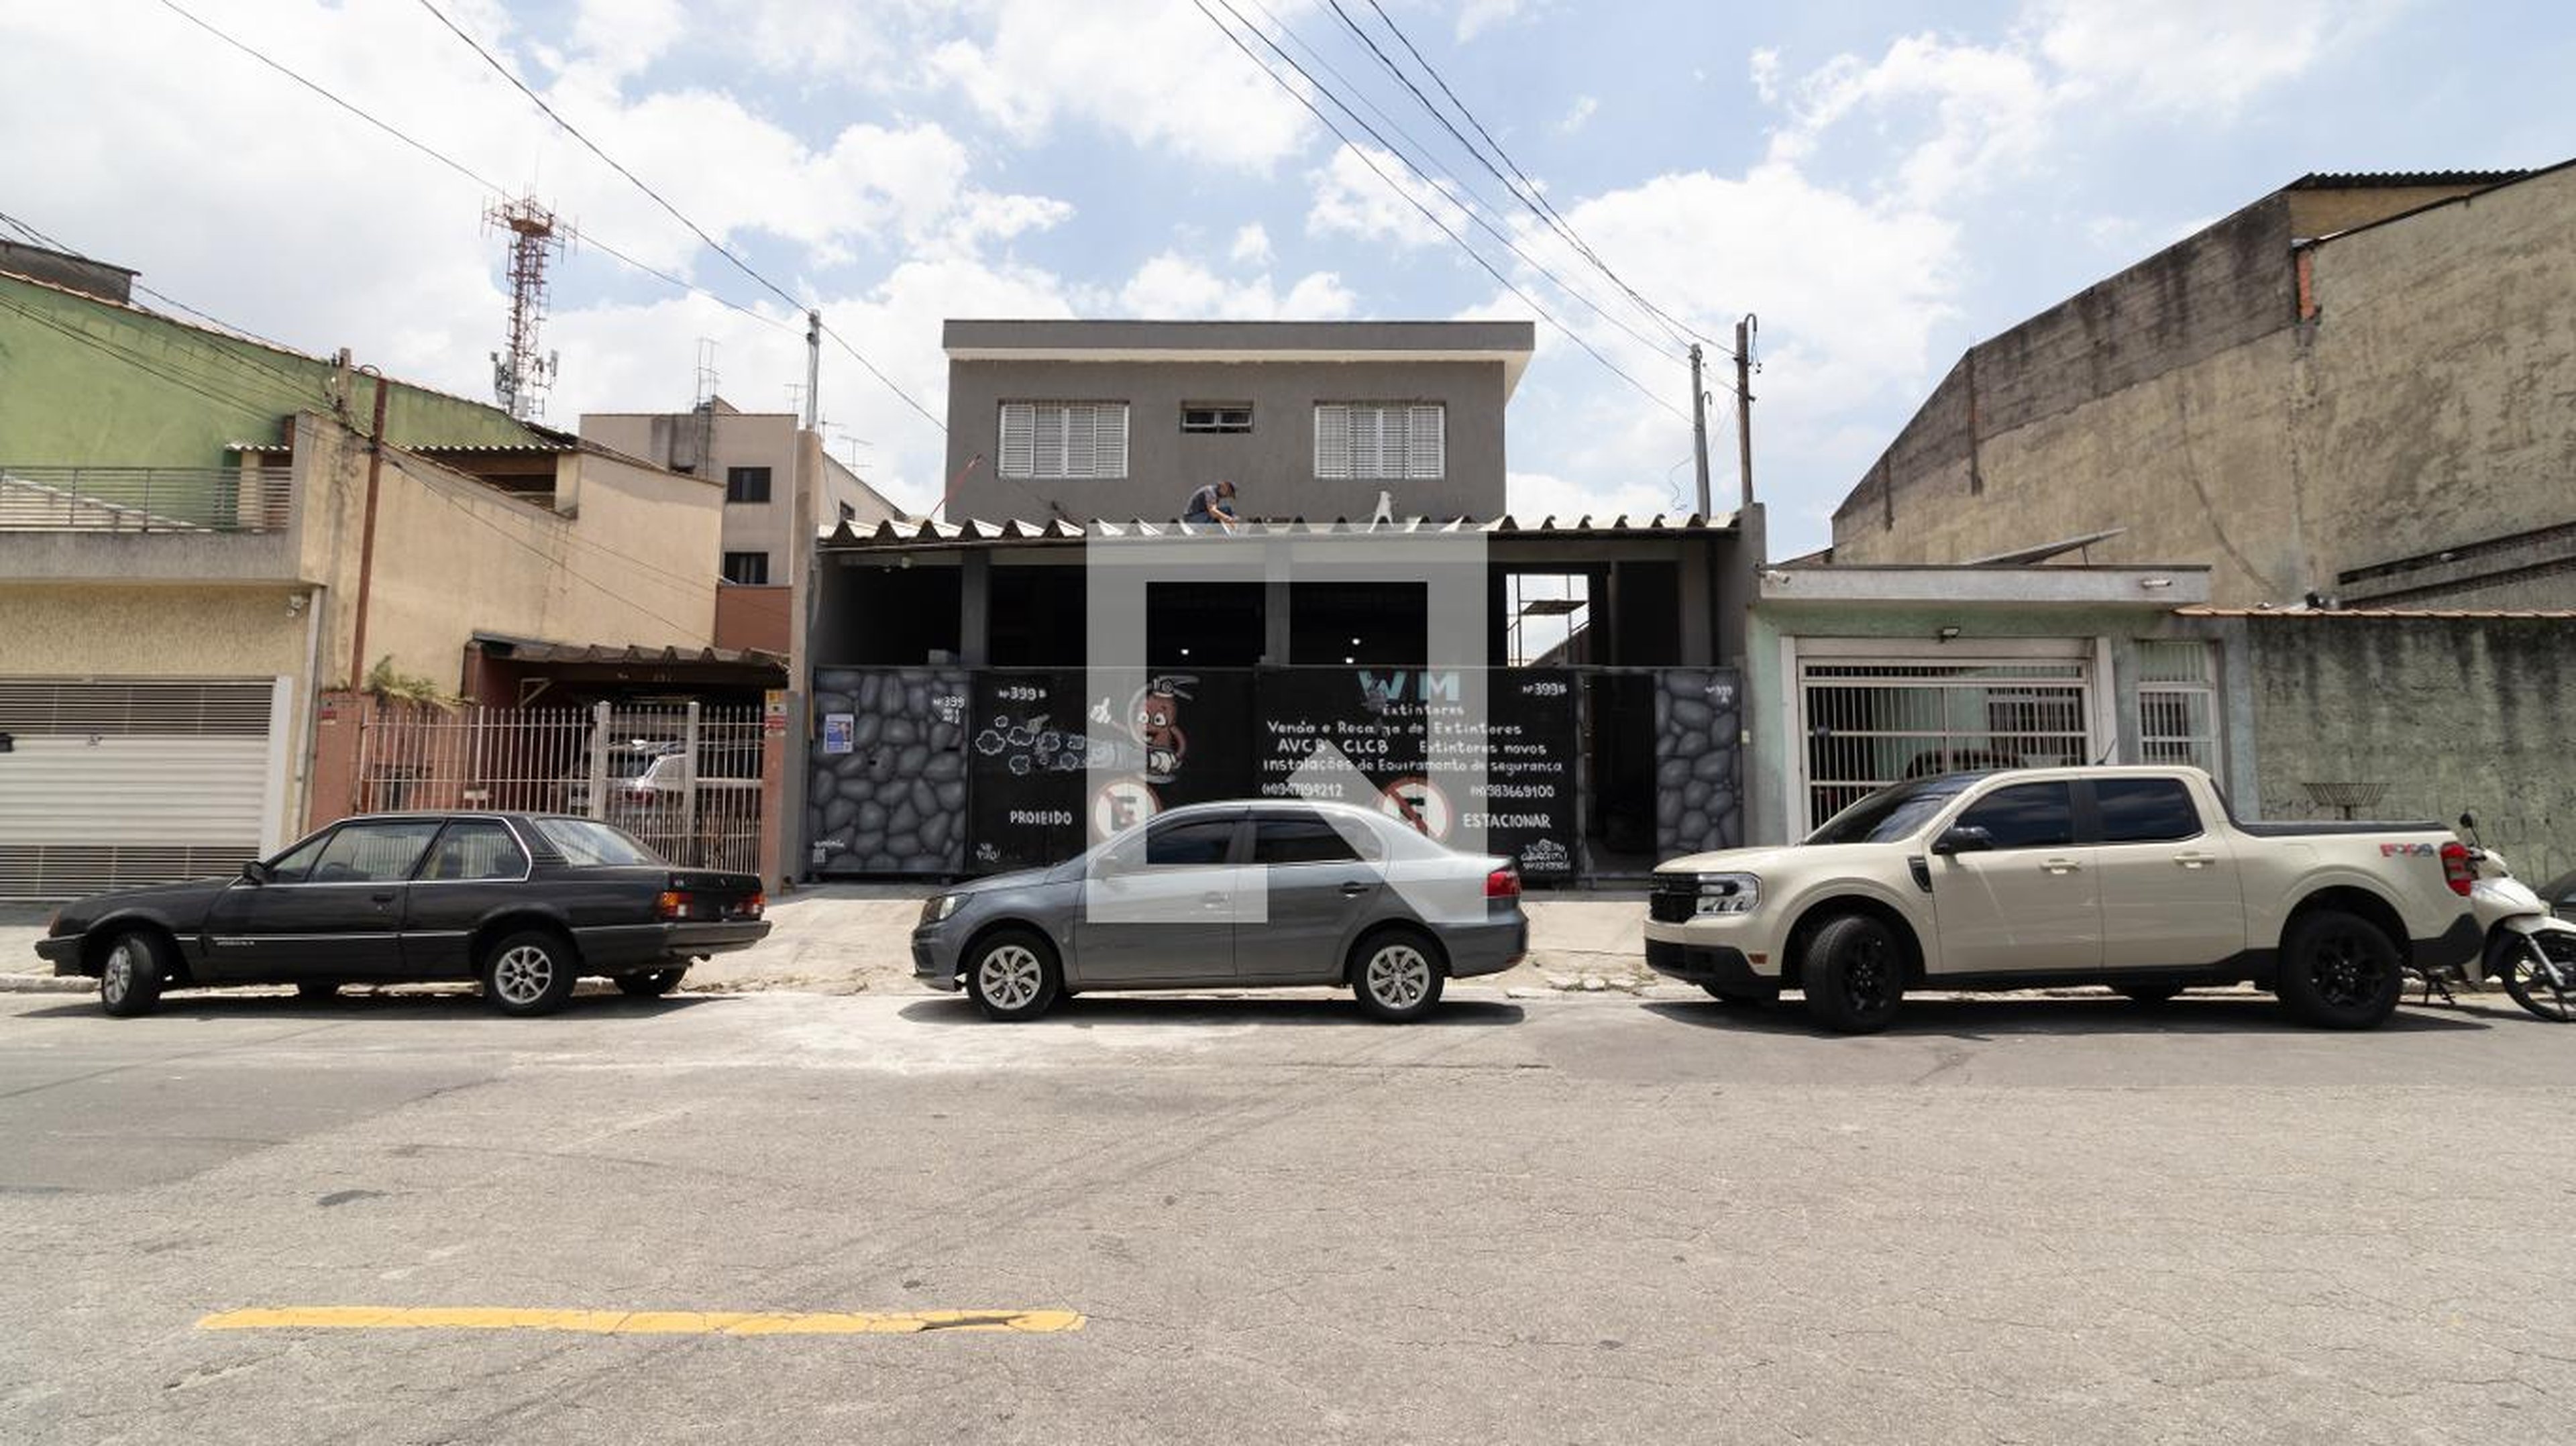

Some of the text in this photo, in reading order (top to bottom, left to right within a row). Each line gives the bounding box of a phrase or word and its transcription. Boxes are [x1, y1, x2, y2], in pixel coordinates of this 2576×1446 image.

[1383, 704, 1464, 716] Extintores
[1267, 720, 1522, 736] Venda e Recaga de Extintores
[1278, 738, 1546, 755] AVCB CLCB Extintores novos
[1358, 759, 1373, 770] de
[1470, 760, 1487, 771] de
[1010, 810, 1072, 825] PROIBIDO
[1463, 813, 1552, 829] ESTACIONAR
